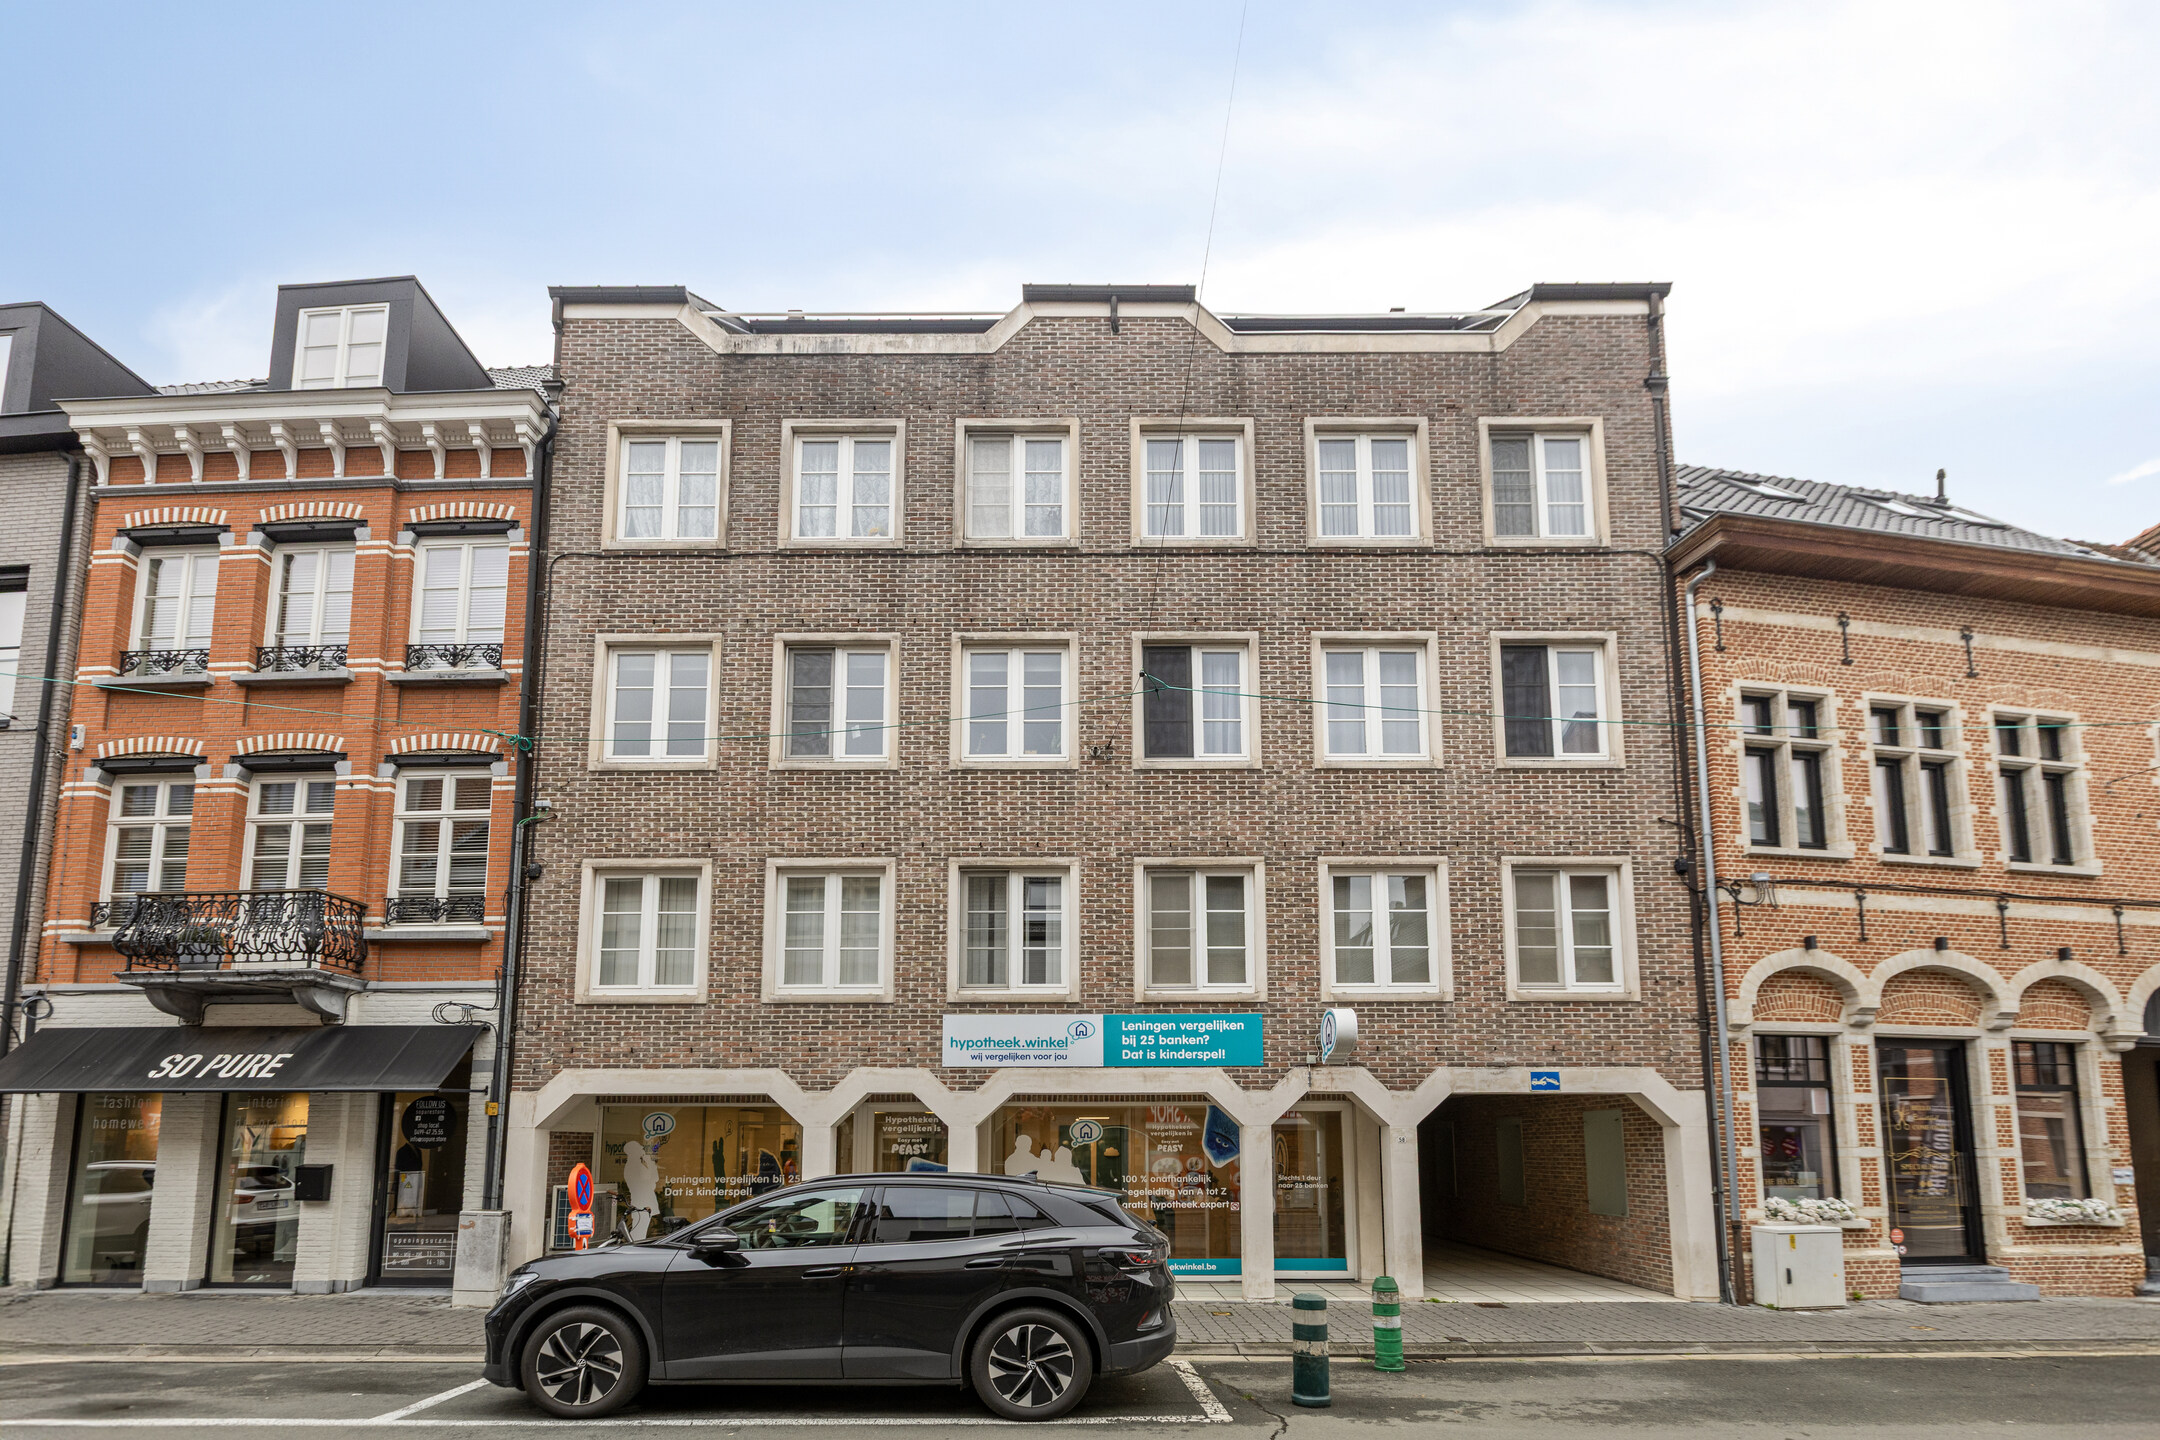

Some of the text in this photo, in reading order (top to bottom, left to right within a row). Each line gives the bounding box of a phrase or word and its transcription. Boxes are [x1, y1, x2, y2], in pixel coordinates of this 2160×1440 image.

[1121, 1019, 1245, 1033] Leningen vergelijken
[949, 1036, 1068, 1051] hypotheek.winkel
[1121, 1034, 1210, 1048] bij 25 banken?
[970, 1052, 1068, 1062] wij vergelijken voor jou
[1121, 1048, 1226, 1062] Dat is kinderspel!
[147, 1053, 294, 1078] SO PURE
[103, 1095, 153, 1109] fashion
[438, 1100, 446, 1108] US
[885, 1116, 938, 1124] Hypotheken
[882, 1125, 932, 1133] vergelijken
[1152, 1123, 1191, 1131] Hypotheken
[891, 1143, 928, 1155] PEASY
[1157, 1144, 1183, 1152] PEASY
[665, 1174, 801, 1186] Leningen vergelijken bij 25
[1121, 1174, 1212, 1185] 100 % onafhankelijk
[664, 1186, 753, 1198] Dat is kinderspel!
[1196, 1188, 1204, 1196] A
[1206, 1188, 1218, 1196] tot
[1221, 1187, 1228, 1196] Z
[1121, 1200, 1230, 1210] gratis hypotheek.expert
[393, 1237, 447, 1245] openingsuren
